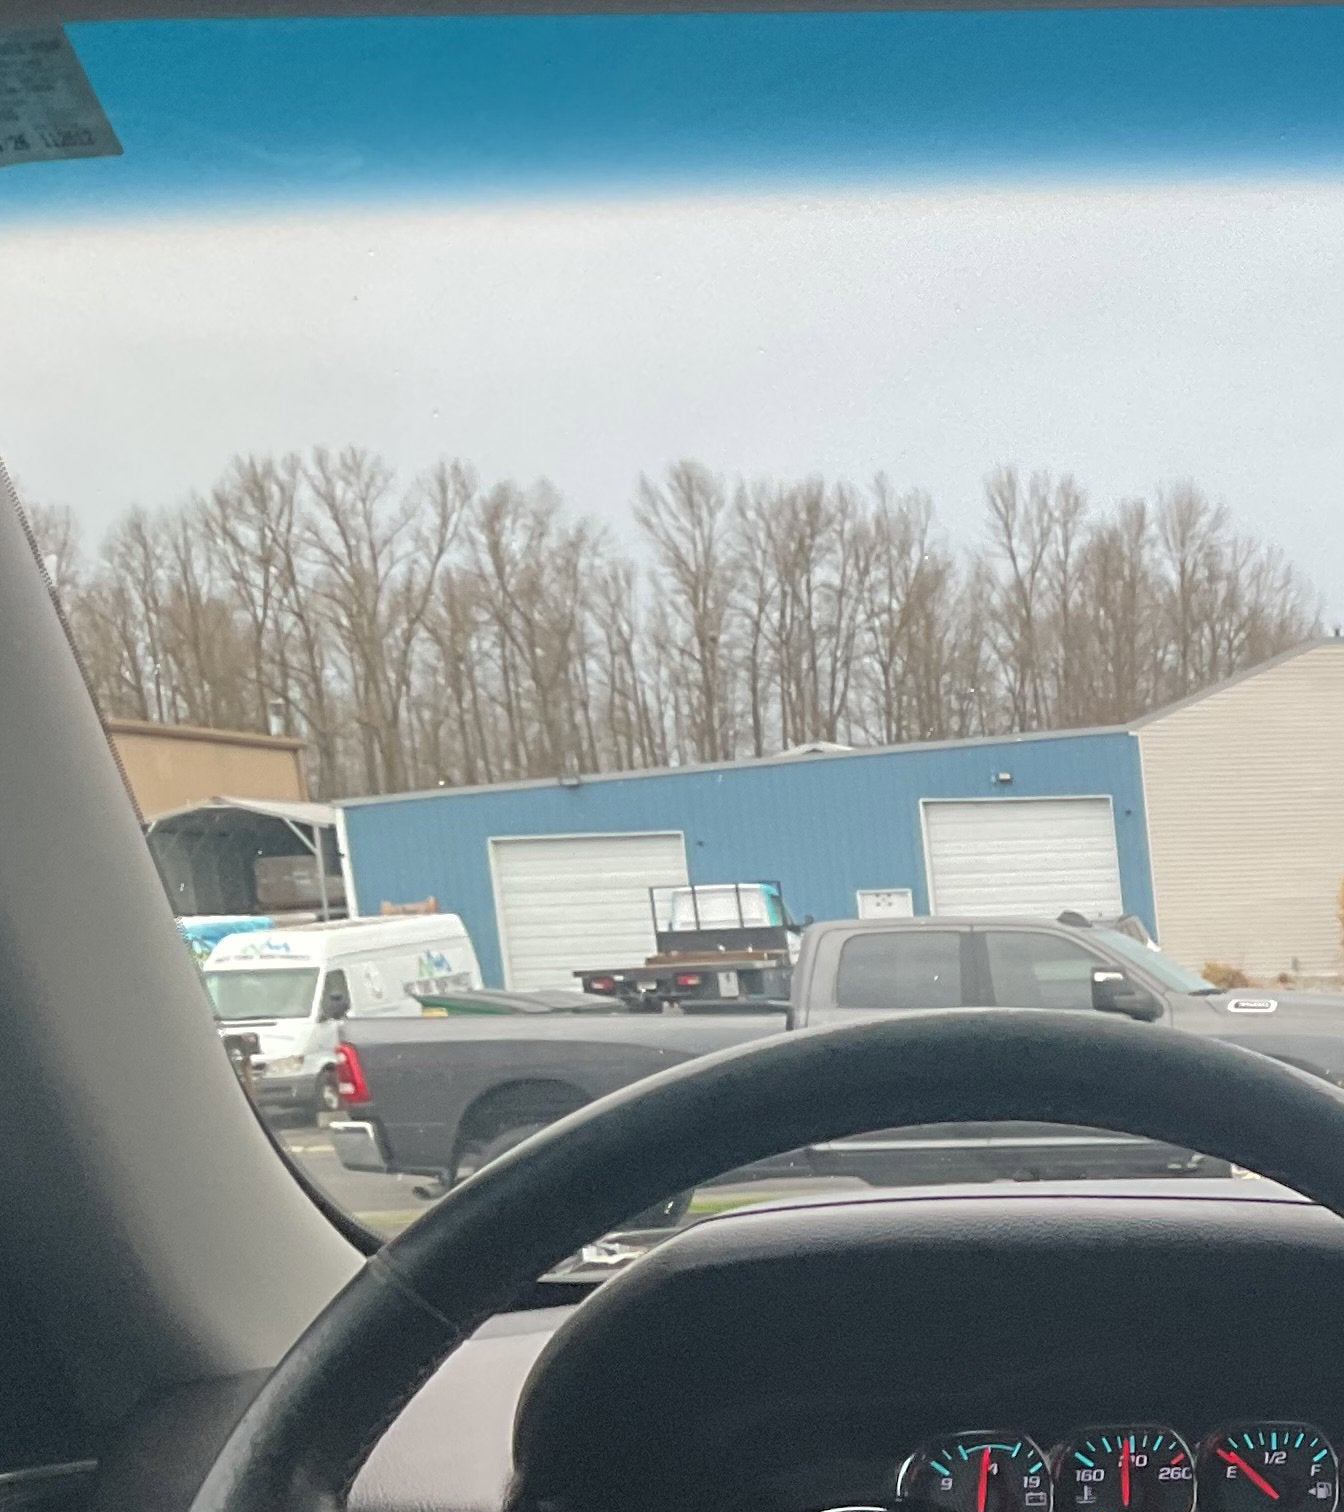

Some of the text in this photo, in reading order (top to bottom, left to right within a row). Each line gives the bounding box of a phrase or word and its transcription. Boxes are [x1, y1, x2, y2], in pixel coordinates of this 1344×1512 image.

[1264, 1451, 1287, 1464] 1/2
[1076, 1468, 1105, 1482] 160
[1158, 1467, 1192, 1480] 260
[1226, 1465, 1238, 1478] E
[1310, 1464, 1321, 1477] F
[941, 1477, 953, 1490] 9
[1023, 1476, 1040, 1488] 19
